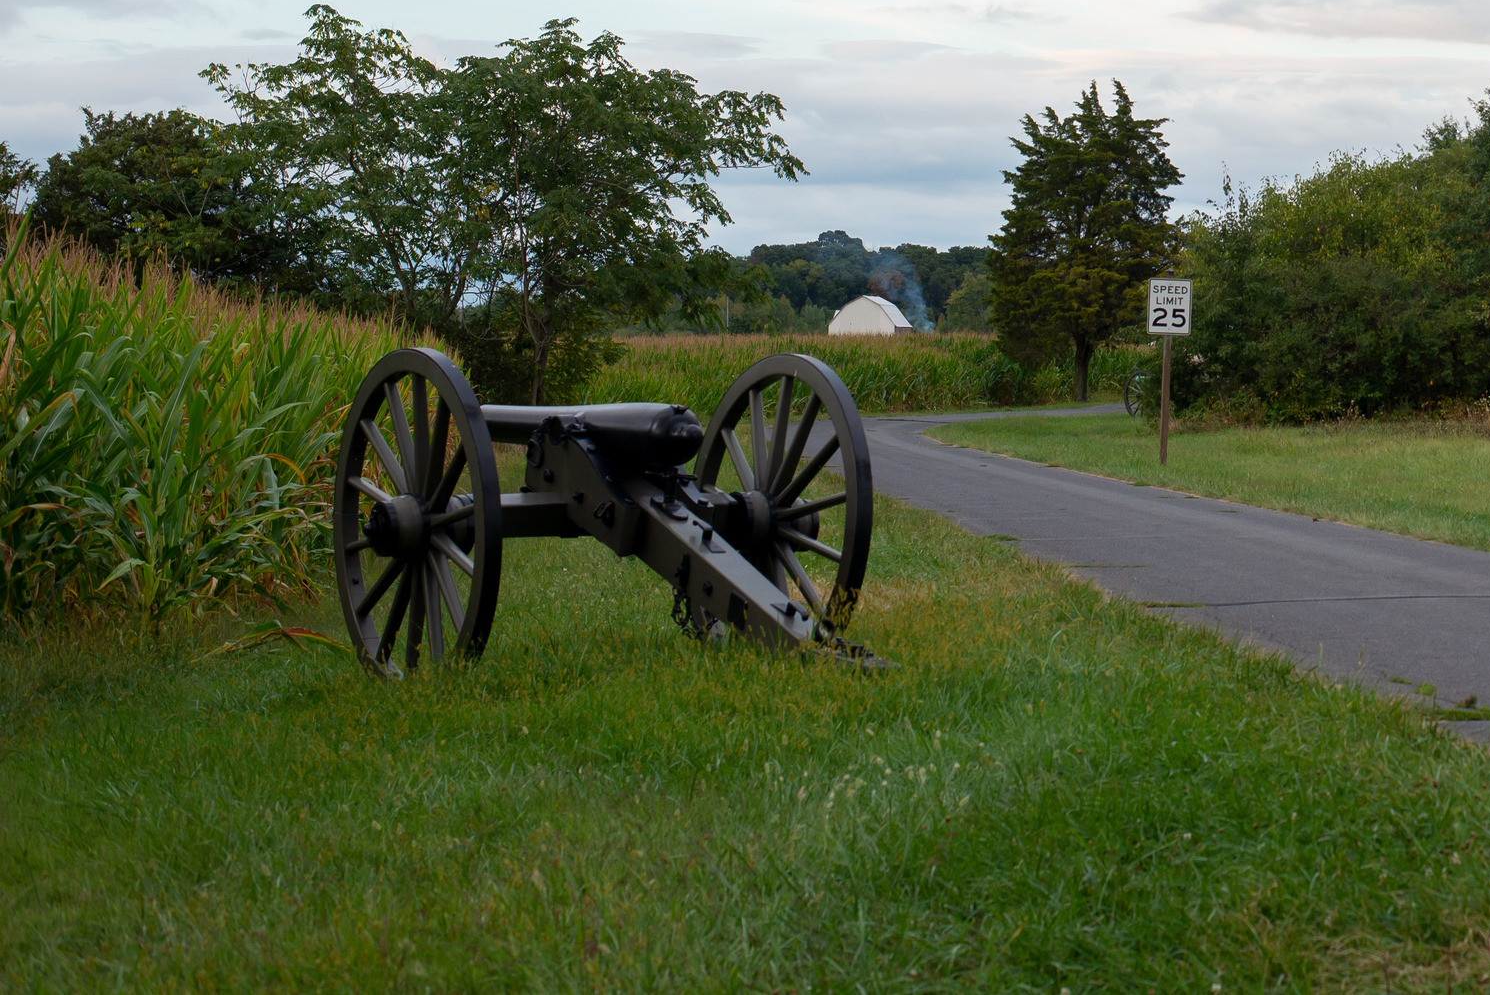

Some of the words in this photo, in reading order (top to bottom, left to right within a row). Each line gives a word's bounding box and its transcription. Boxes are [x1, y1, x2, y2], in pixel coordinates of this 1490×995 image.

[1153, 285, 1188, 294] SPEED
[1156, 296, 1184, 305] LIMIT
[1152, 308, 1186, 328] 25
